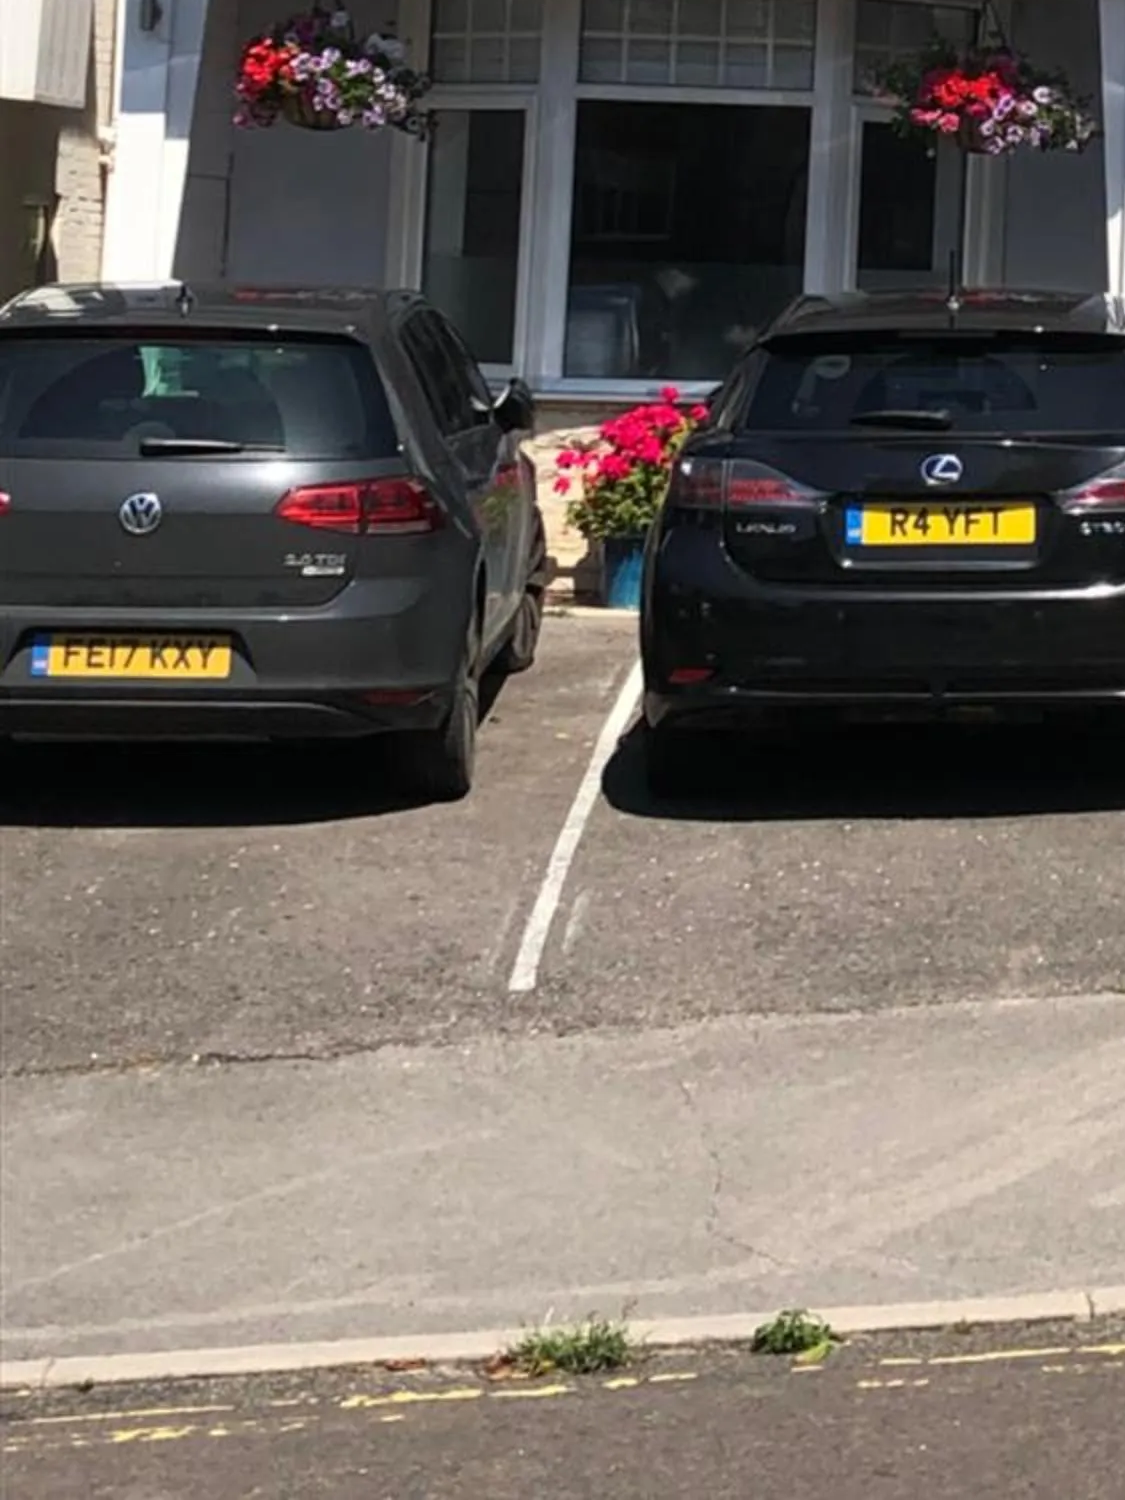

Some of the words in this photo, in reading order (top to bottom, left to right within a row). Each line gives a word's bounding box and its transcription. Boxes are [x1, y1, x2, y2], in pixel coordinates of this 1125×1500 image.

[890, 506, 931, 537] R4
[943, 506, 1004, 536] YFT
[63, 636, 140, 669] FE17
[150, 637, 217, 670] KXY
